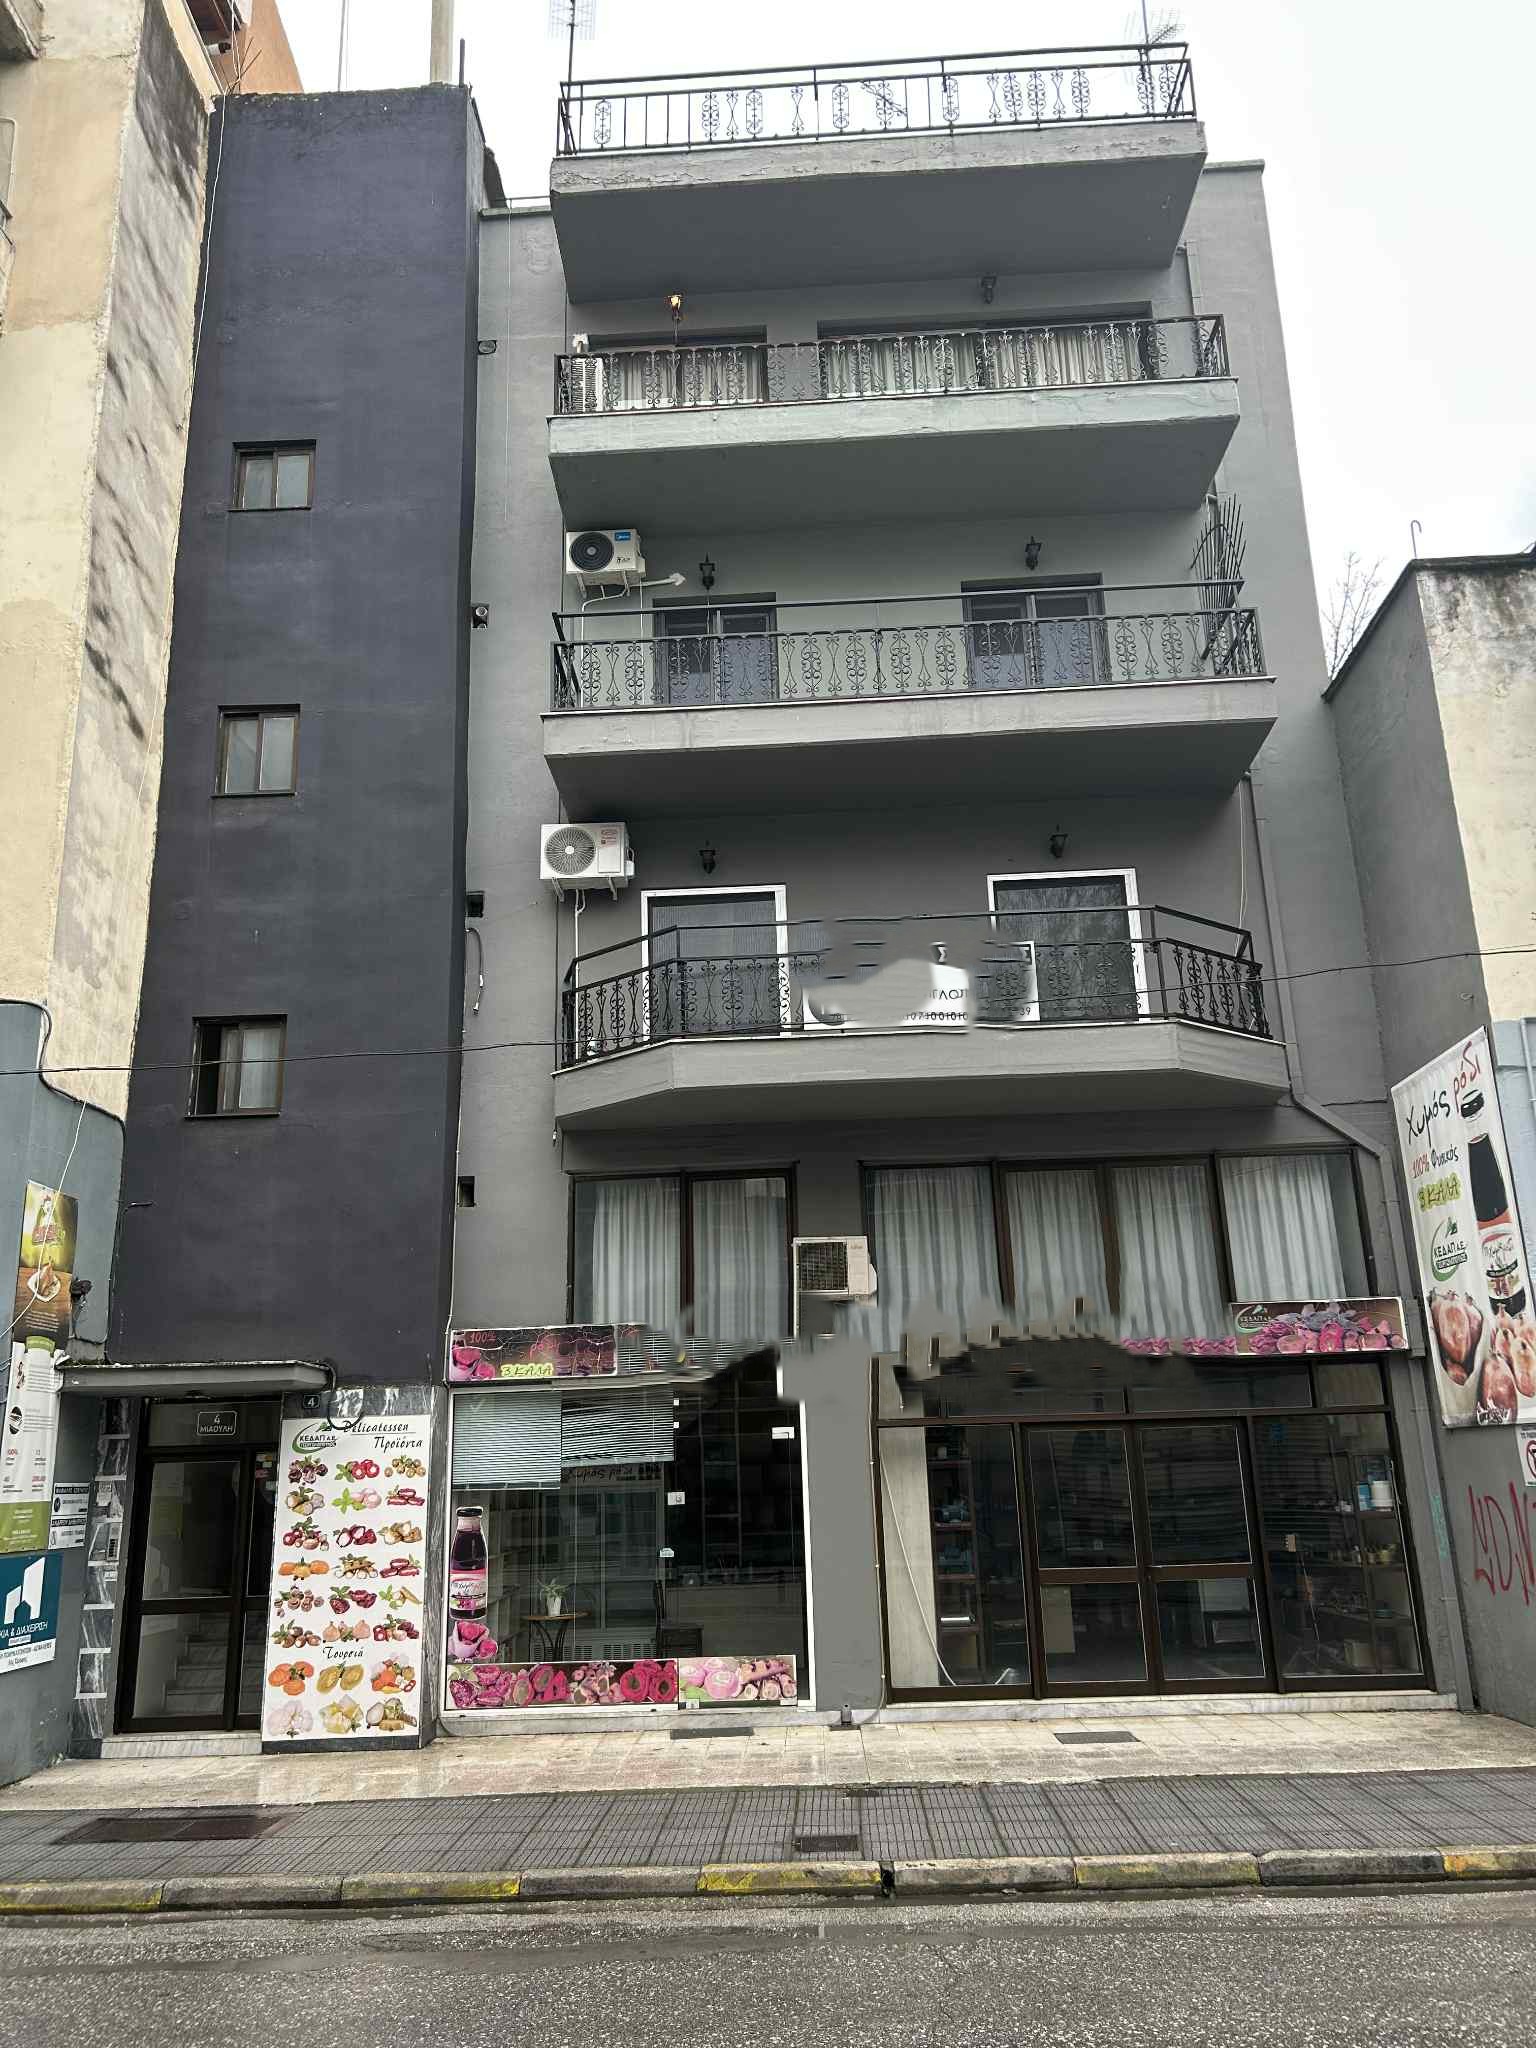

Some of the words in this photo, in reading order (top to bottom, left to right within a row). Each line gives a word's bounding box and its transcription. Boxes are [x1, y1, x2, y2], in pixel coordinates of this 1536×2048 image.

[1406, 1090, 1451, 1148] Χυμός
[1453, 1041, 1482, 1114] ρόδι
[307, 1397, 315, 1407] 4
[213, 1414, 221, 1425] 4
[200, 1425, 233, 1433] ΜΙΑΟΥΛΗ
[343, 1420, 409, 1434] Delicatessen
[299, 1434, 325, 1442] ΚΕΔΑΠ
[323, 1646, 364, 1660] Τουρσιά
